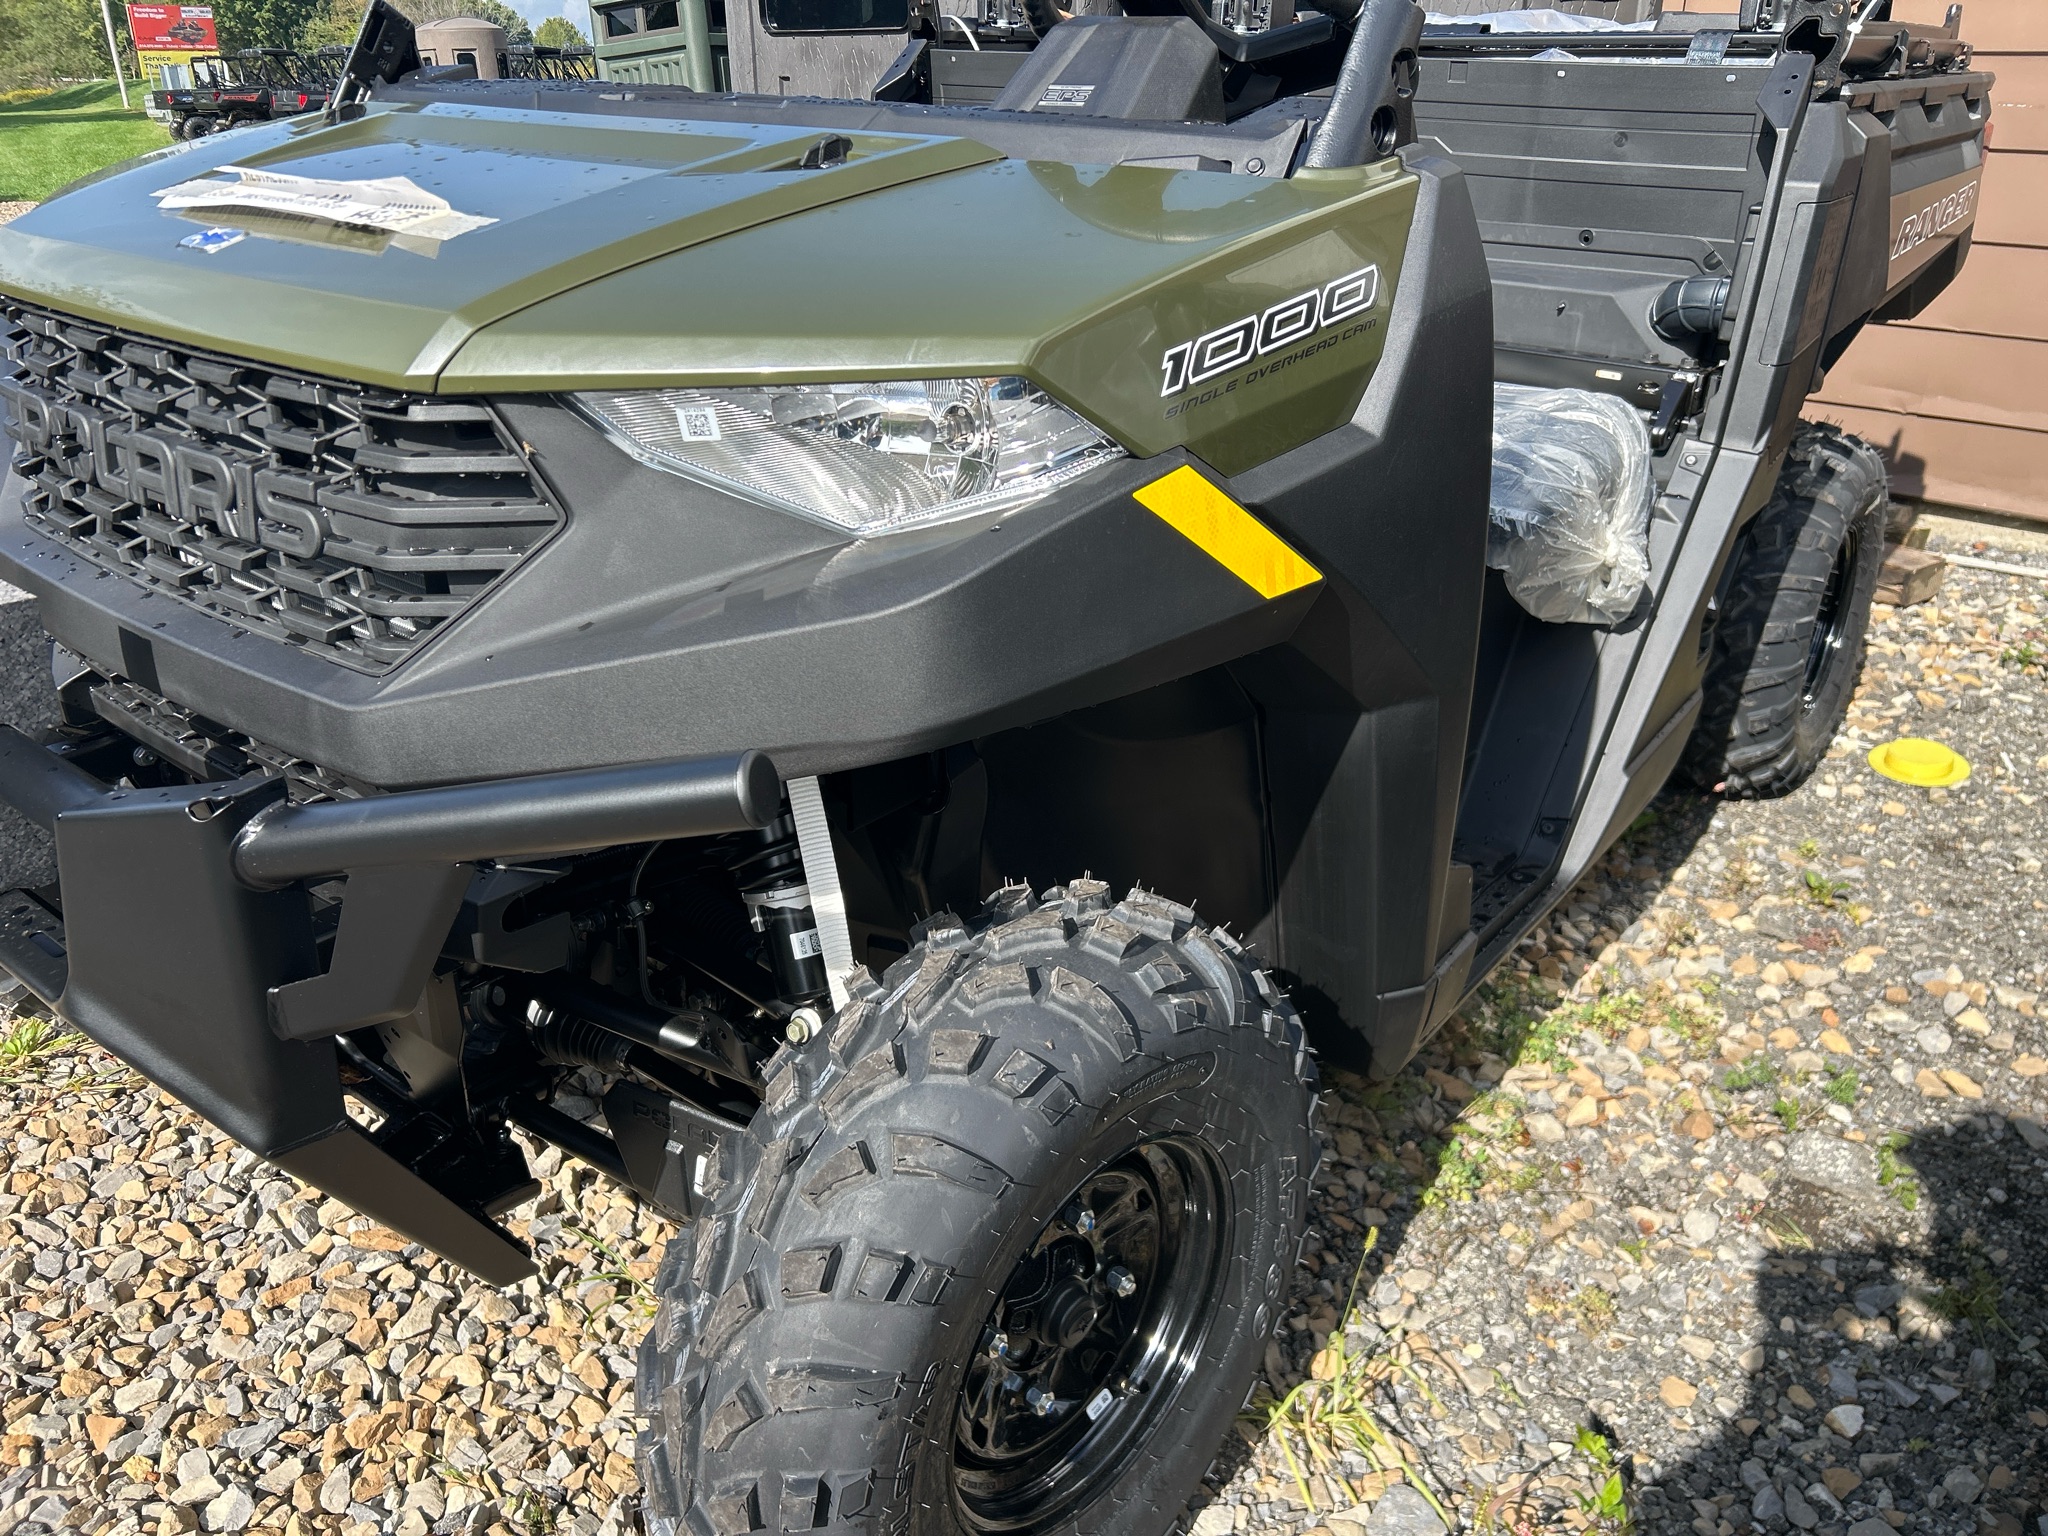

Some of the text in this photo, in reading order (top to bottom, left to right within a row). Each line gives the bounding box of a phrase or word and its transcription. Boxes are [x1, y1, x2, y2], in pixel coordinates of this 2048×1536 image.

[1041, 90, 1092, 102] EPS
[1890, 180, 1977, 261] RANGER
[1161, 263, 1378, 398] 1000
[1164, 318, 1378, 420] SINGLE OVERHEAD CAM
[18, 386, 328, 559] POLARIS
